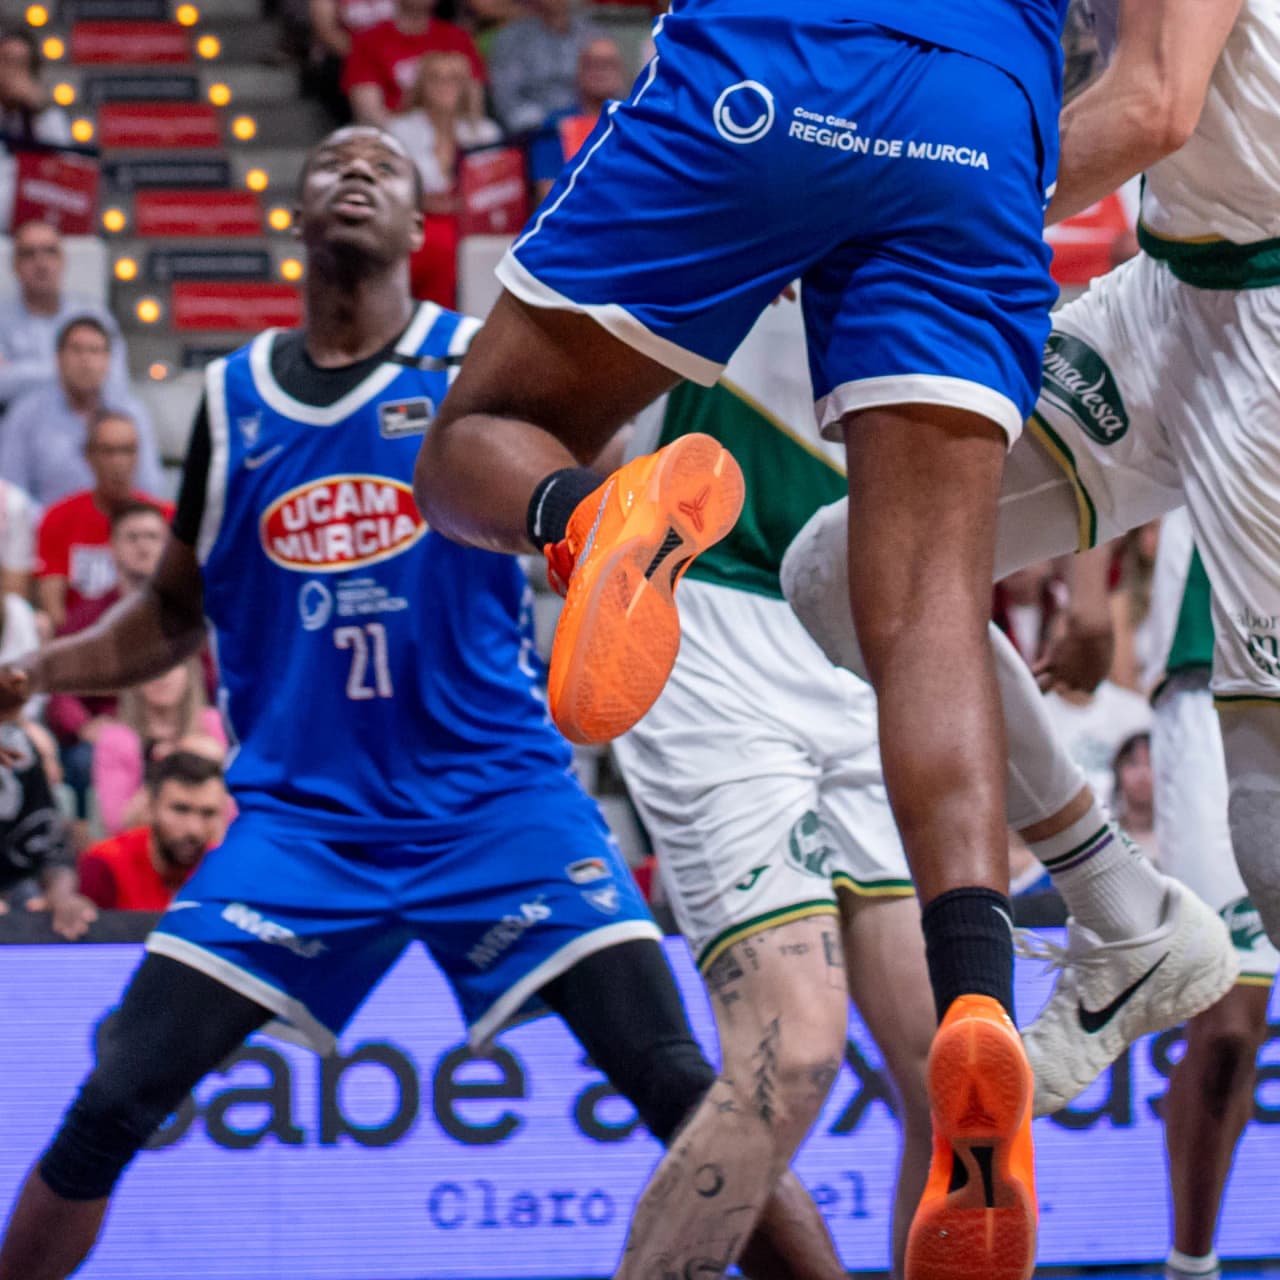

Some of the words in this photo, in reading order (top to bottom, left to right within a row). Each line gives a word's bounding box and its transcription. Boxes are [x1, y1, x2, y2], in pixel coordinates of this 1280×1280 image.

[788, 121, 870, 154] REGIÓN
[873, 139, 905, 158] DE
[907, 141, 989, 170] MURCIA
[1042, 346, 1124, 437] madesa
[281, 482, 399, 532] UCAM
[273, 514, 417, 563] MURCIA
[333, 622, 394, 700] 21
[427, 1181, 616, 1229] Claro
